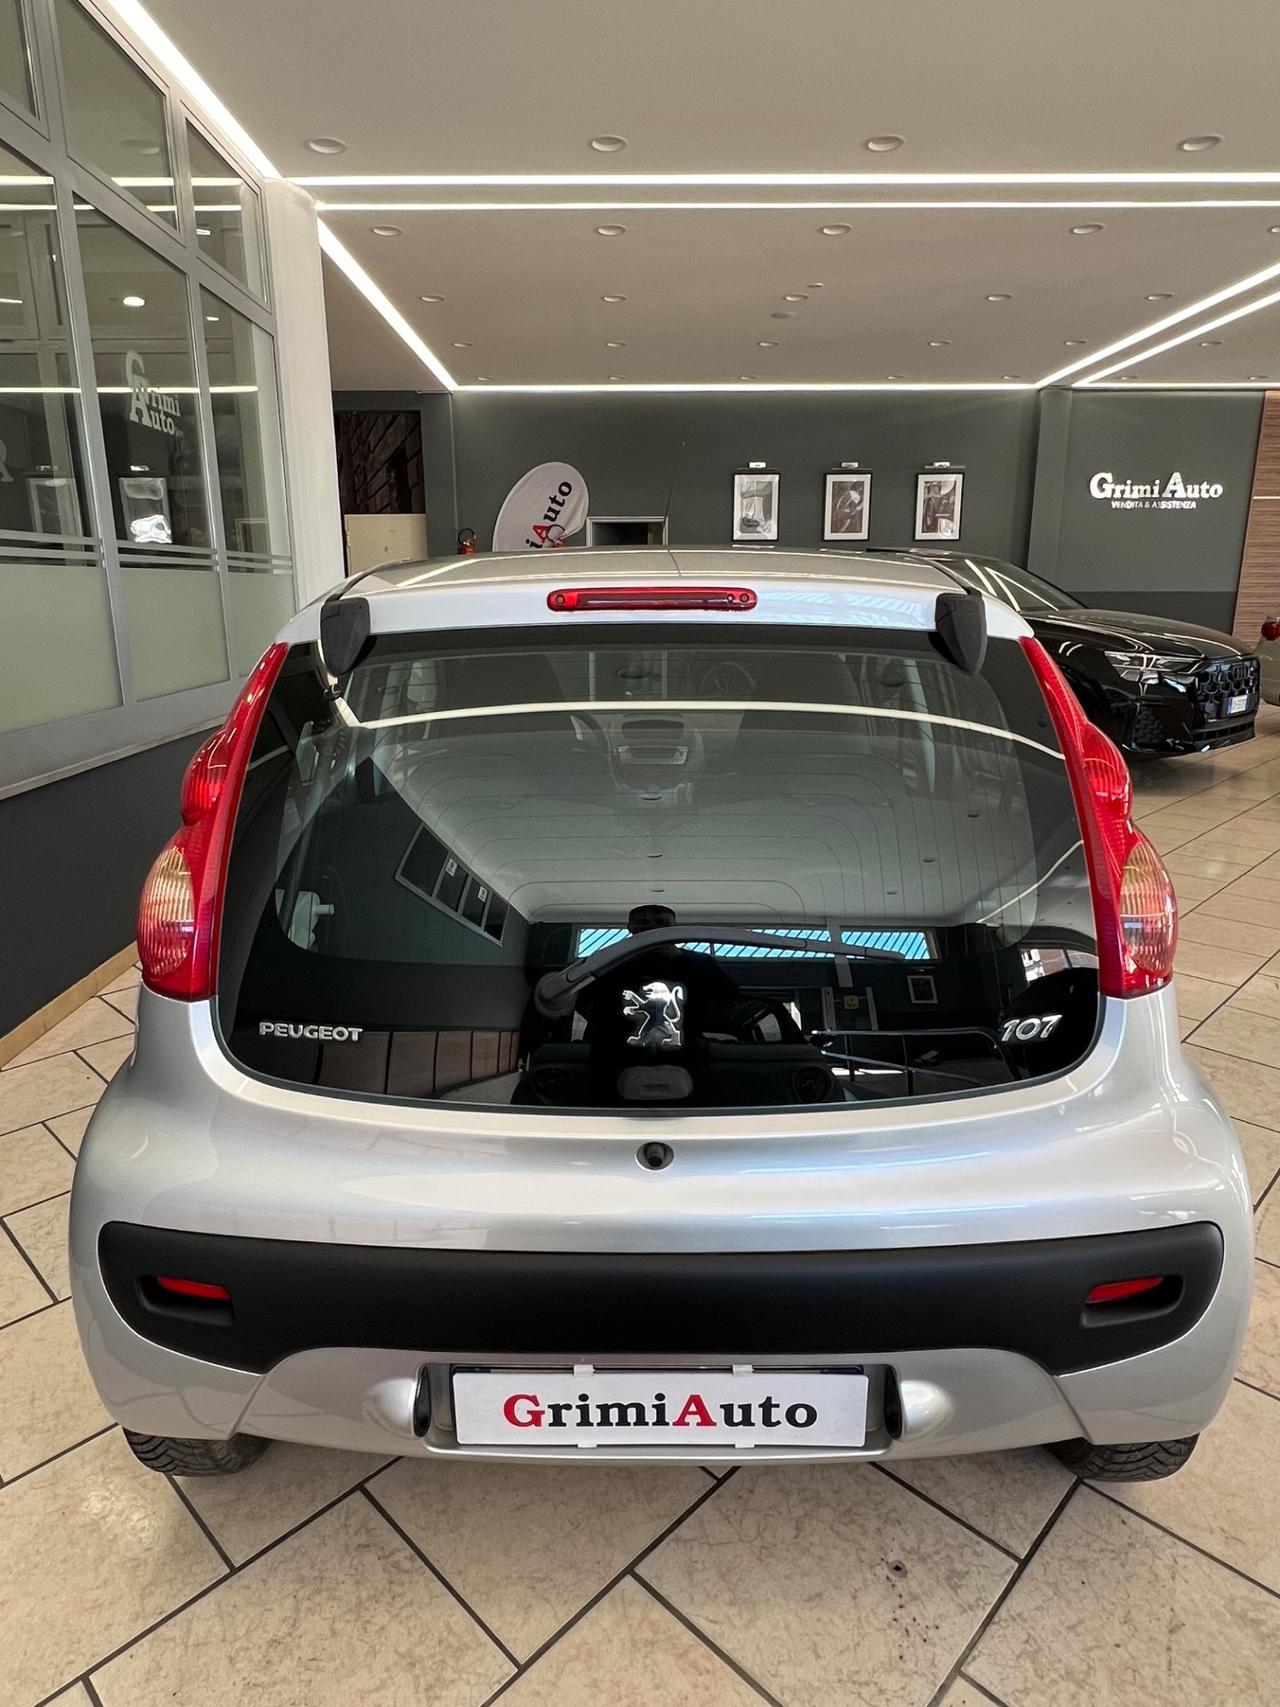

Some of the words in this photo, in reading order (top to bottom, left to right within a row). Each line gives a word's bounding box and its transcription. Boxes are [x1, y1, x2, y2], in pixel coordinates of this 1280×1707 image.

[130, 375, 175, 435] Auto
[1089, 472, 1160, 499] Grimi
[1162, 471, 1224, 499] Auto
[1111, 500, 1143, 509] VENDITA
[1151, 500, 1197, 509] ASSISTENZA
[259, 1022, 363, 1042] PEUGEOT
[1001, 1014, 1063, 1042] 107
[503, 1393, 818, 1428] GrimiAuto
